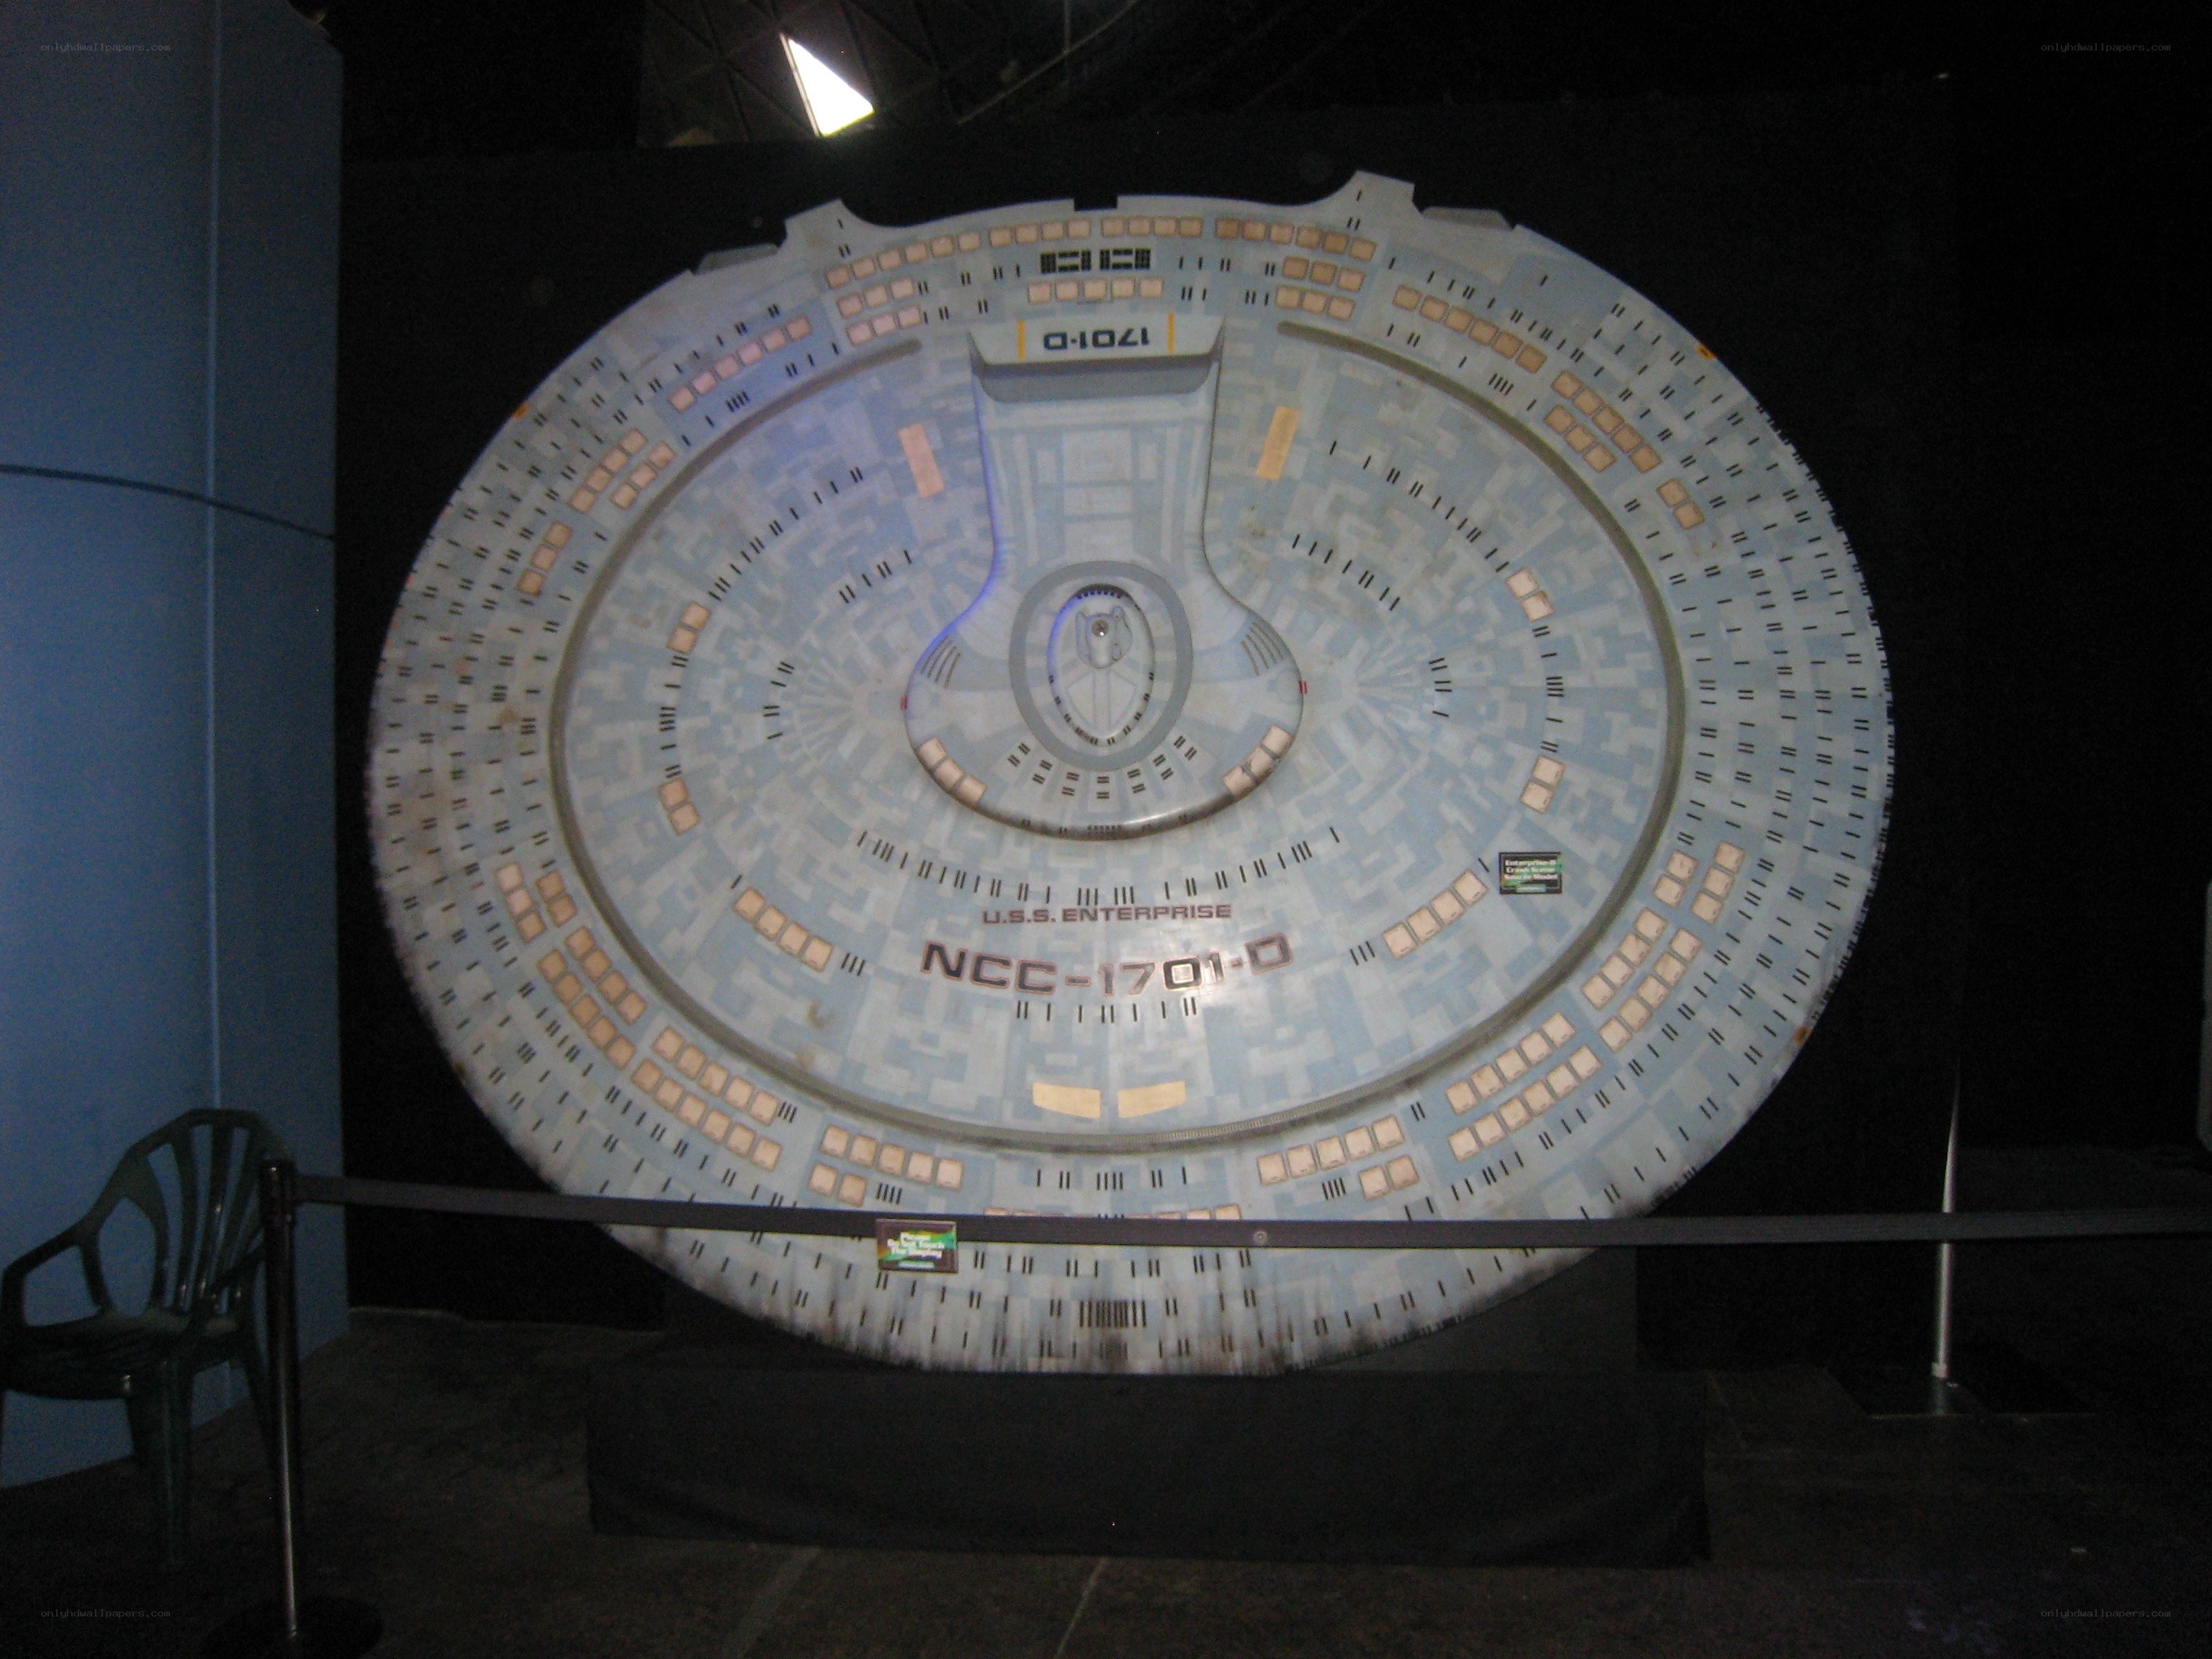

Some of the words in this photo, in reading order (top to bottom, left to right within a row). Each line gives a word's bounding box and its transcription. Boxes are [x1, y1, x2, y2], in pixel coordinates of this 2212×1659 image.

[1043, 327, 1150, 350] 1701-D
[981, 909, 1056, 925] U.S.S.
[1061, 904, 1233, 923] ENTERPRISE
[920, 933, 1295, 997] NCC-1701-D
